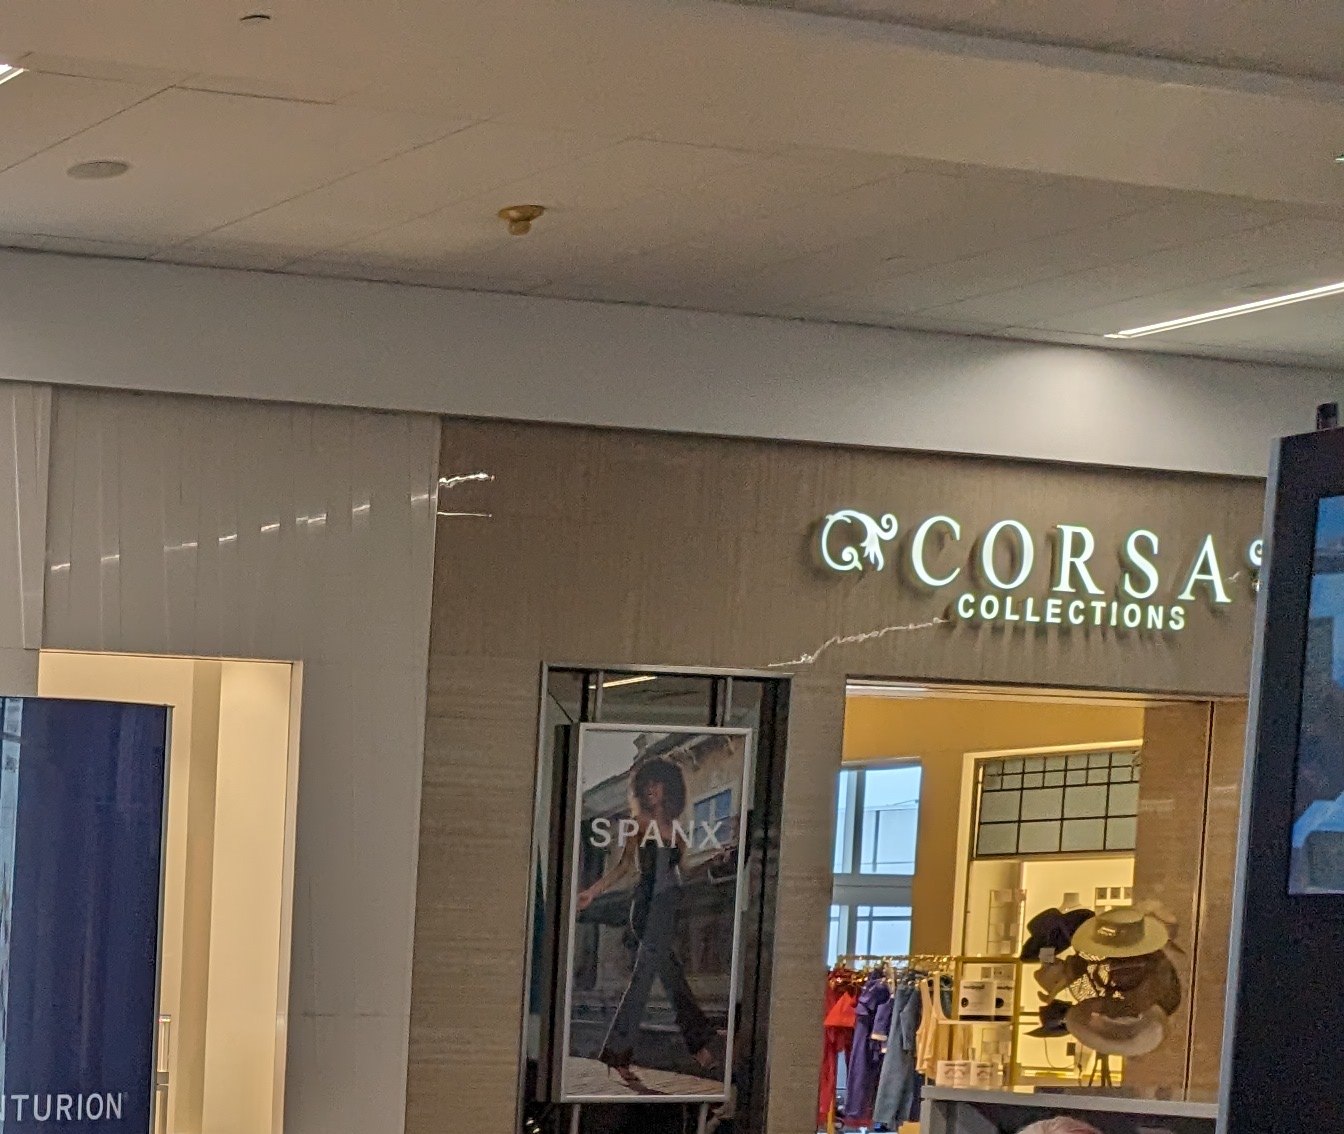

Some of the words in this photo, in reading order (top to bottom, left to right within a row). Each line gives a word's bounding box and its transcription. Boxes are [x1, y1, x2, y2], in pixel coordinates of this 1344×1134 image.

[911, 513, 1232, 605] CORSA
[957, 594, 1187, 632] COLLECTIONS
[588, 816, 725, 851] SPANX
